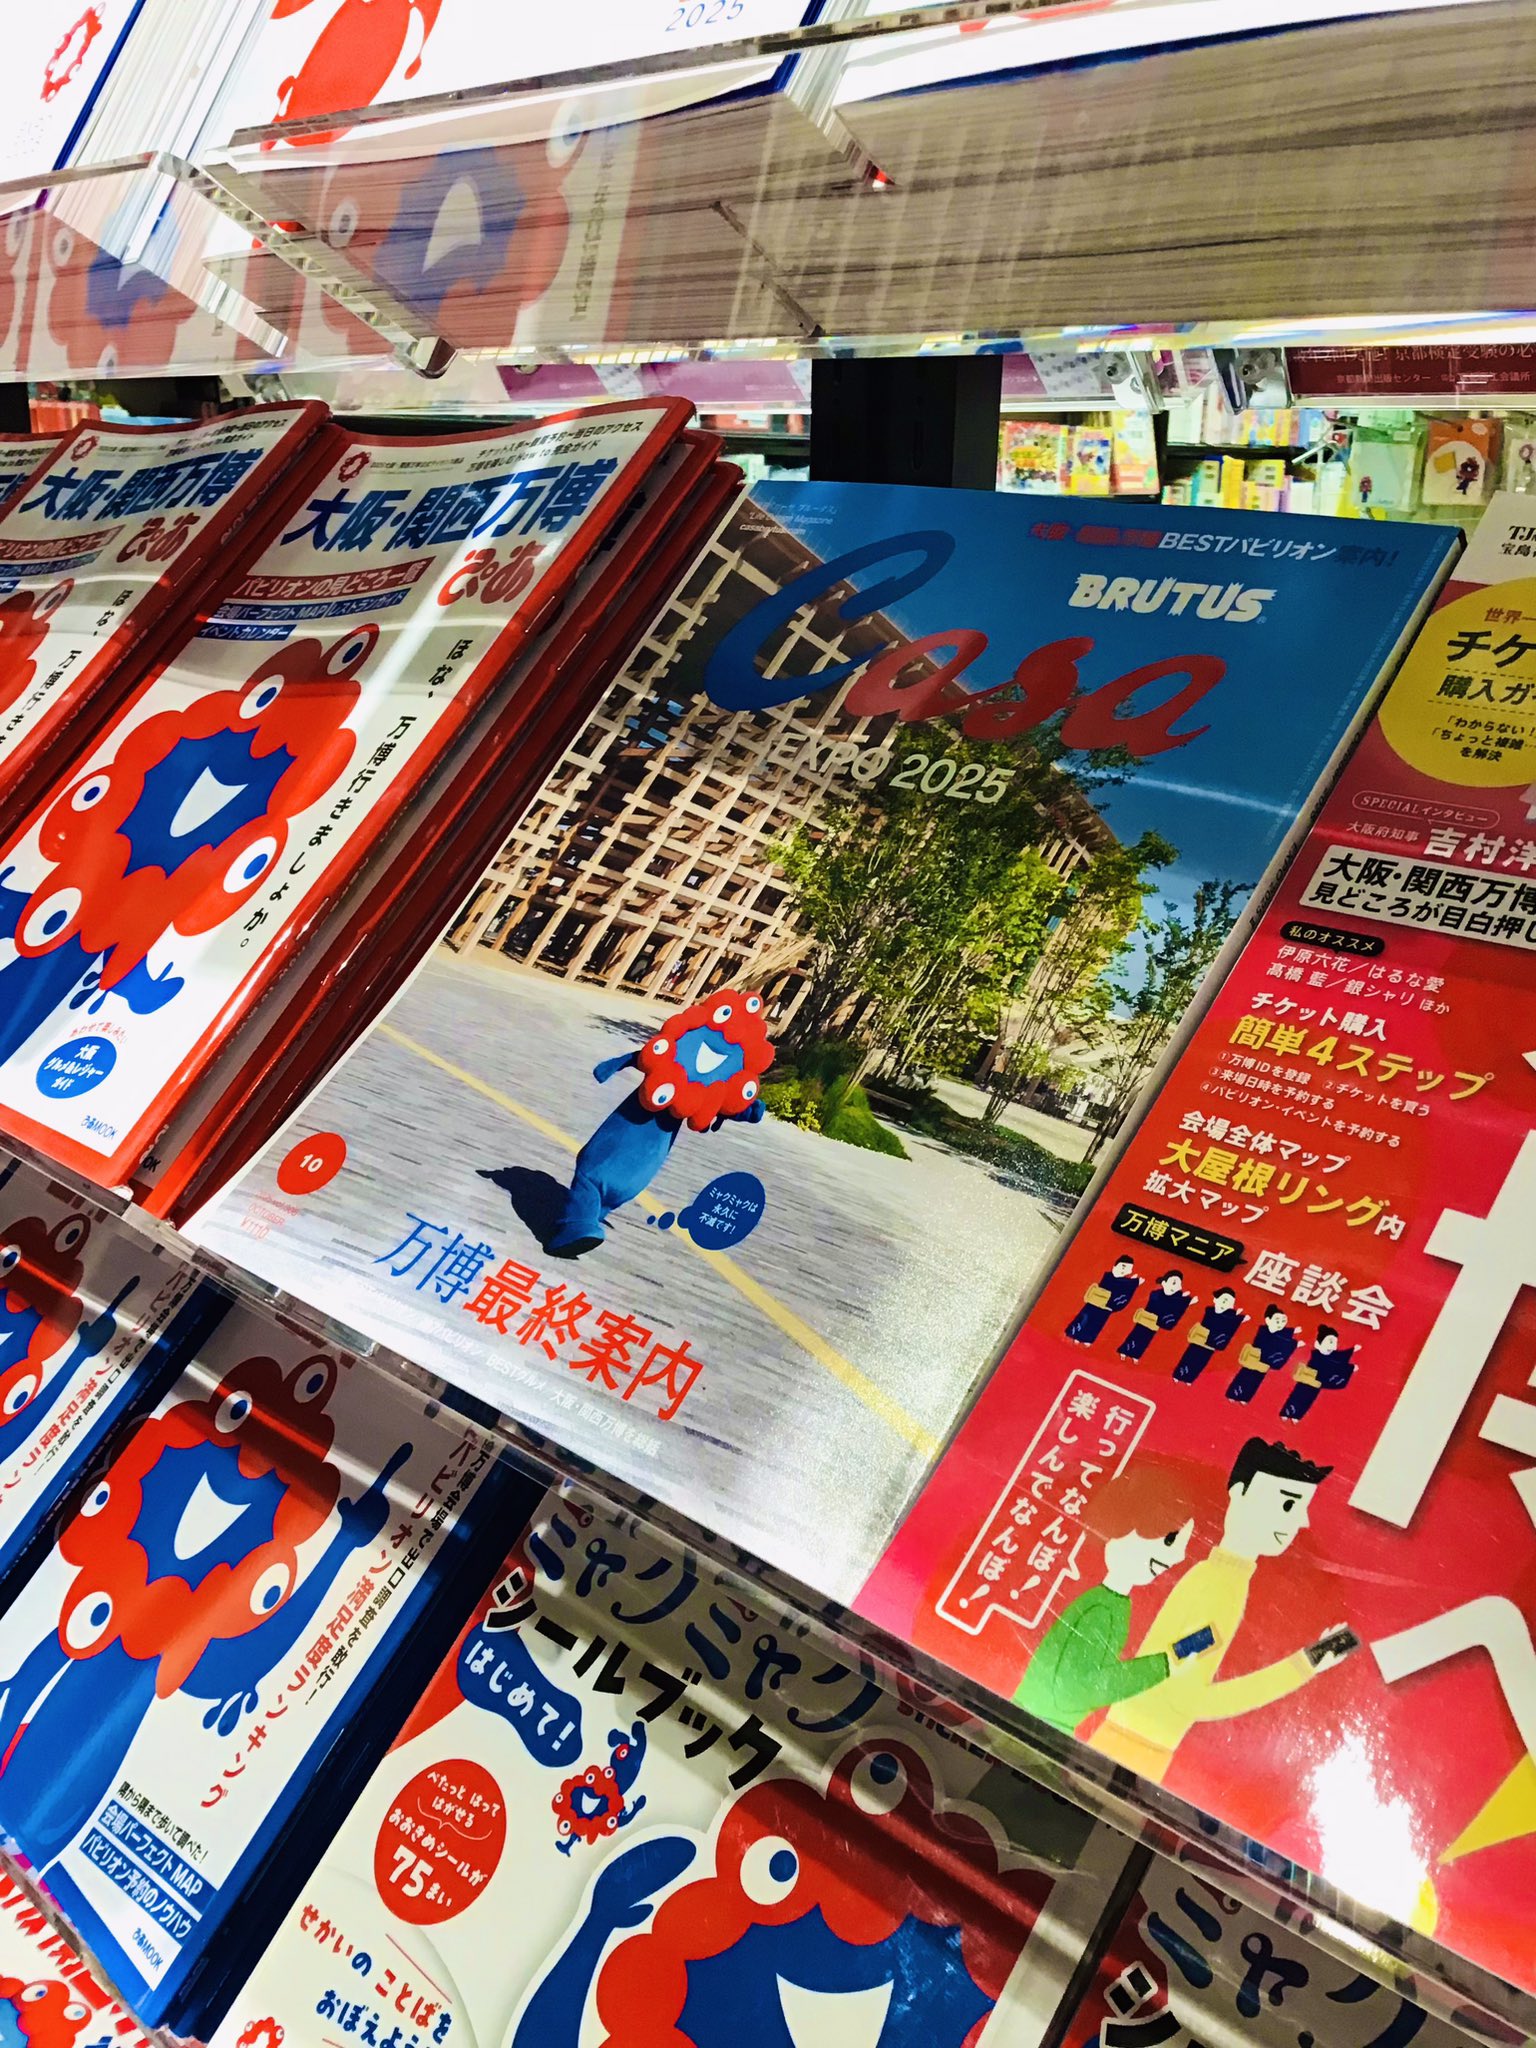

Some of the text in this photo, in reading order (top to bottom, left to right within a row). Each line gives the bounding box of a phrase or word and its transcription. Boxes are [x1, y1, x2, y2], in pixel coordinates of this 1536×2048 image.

[19, 447, 265, 521] 大阪・関西万博
[280, 457, 619, 553] 大阪・関西万博
[200, 622, 290, 641] イベントカレンダー
[1068, 573, 1278, 624] BRUTUS
[703, 529, 1227, 757] Casa
[1436, 674, 1536, 706] 購入ガ
[767, 731, 1017, 804] EXPO 2025
[1346, 821, 1420, 842] 大阪府知事
[1288, 925, 1375, 952] 私のオススメ
[1251, 991, 1387, 1042] チケット購入
[1418, 998, 1450, 1015] ほか
[1228, 1013, 1495, 1101] 簡単4ステップ
[299, 1153, 324, 1173] 10
[1178, 1109, 1352, 1174] 会場全体マップ
[698, 1211, 737, 1235] 不滅です!
[712, 1203, 740, 1221] 永久に
[1142, 1169, 1270, 1225] 拡大マップ
[1158, 1138, 1407, 1241] 大屋根リング内
[1120, 1209, 1235, 1262] 万博マニア
[371, 1211, 705, 1422] 万博最終案内
[1243, 1250, 1395, 1331] 座談会
[957, 1388, 1101, 1610] 楽しんでなんぼ!
[1009, 1405, 1136, 1601] 行ってなんぼ!
[464, 1639, 580, 1752] はじめて!
[482, 1565, 783, 1792] シールブック
[388, 1808, 488, 1887] おおきめシールが
[432, 1796, 476, 1829] はがせる
[82, 1832, 192, 1939] パビリオン予約のノウハウ
[101, 1803, 204, 1898] 会場パーフェクト MAP
[131, 1927, 164, 1972] ぴあMOOK
[300, 1904, 452, 2045] せかいの ことばを
